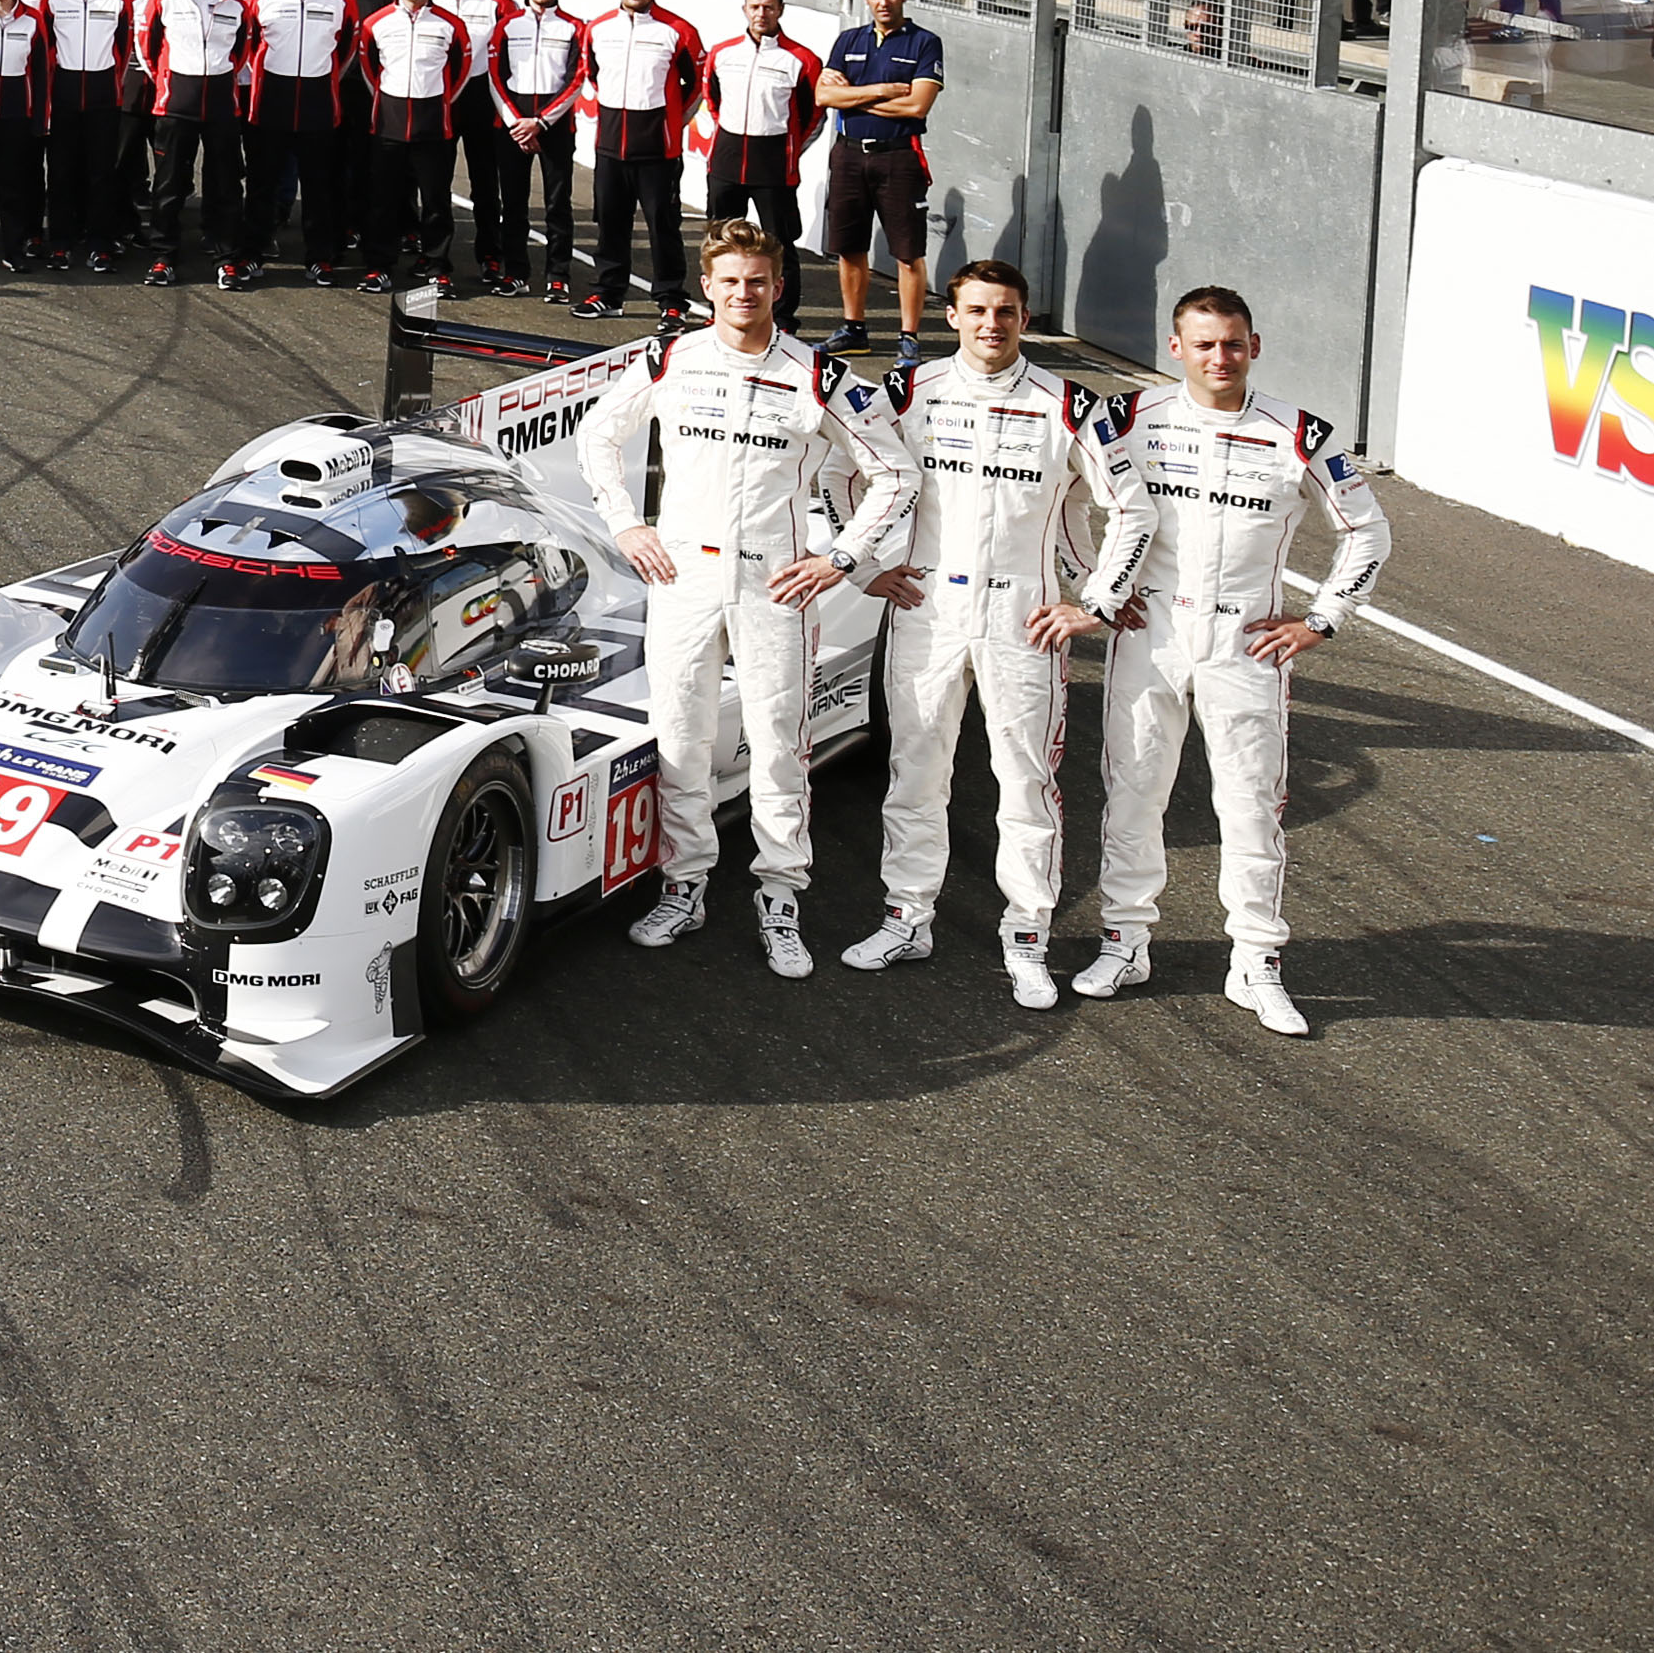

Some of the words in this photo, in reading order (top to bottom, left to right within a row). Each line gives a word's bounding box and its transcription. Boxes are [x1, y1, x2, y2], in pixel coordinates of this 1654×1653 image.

[498, 419, 556, 460] DMG
[679, 425, 726, 441] DMG
[733, 433, 789, 449] MORI
[1148, 423, 1172, 431] DMG
[1148, 439, 1185, 454] Mobil
[325, 450, 360, 480] Mobil
[923, 456, 974, 474] DMG
[982, 466, 1042, 483] MORI
[1147, 481, 1200, 499] DMG
[1209, 492, 1272, 512] MORI
[143, 529, 343, 581] PORSCHE
[739, 551, 763, 562] Nico
[1126, 533, 1149, 575] MORI
[988, 578, 1010, 589] Earl
[1215, 603, 1241, 617] Nick
[534, 657, 600, 679] CHOPARD
[76, 714, 176, 754] MORI
[11, 755, 37, 770] LE
[35, 759, 92, 785] MANS
[629, 760, 639, 773] LE
[559, 786, 583, 831] P1
[609, 784, 654, 879] 19
[125, 834, 181, 860] P1
[94, 858, 146, 880] Mobil
[363, 866, 420, 892] SCHAEFFLER
[77, 881, 141, 904] CHOPARD
[399, 889, 418, 905] FAG
[213, 970, 264, 987] DMG
[267, 973, 321, 987] MORI
